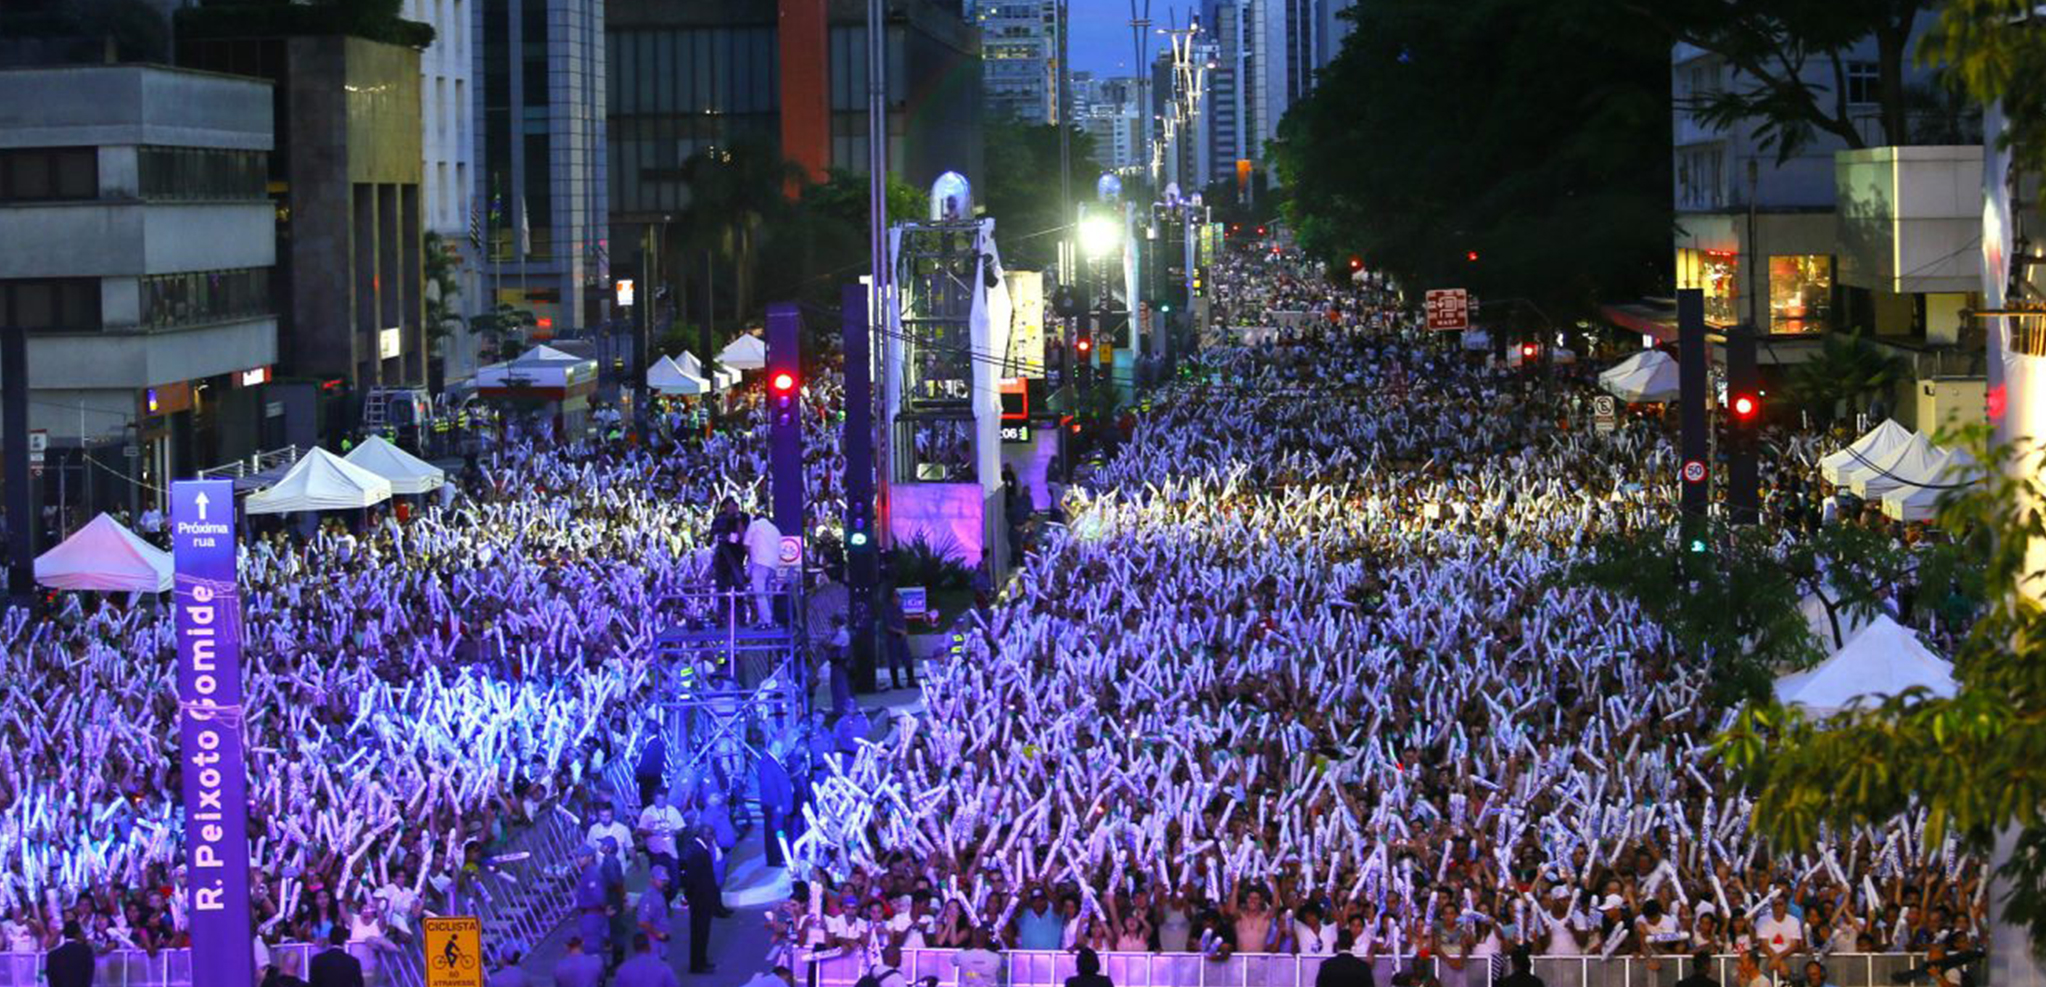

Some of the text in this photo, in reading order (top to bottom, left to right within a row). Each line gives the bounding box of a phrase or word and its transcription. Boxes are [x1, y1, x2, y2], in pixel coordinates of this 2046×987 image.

[1688, 465, 1702, 476] 50
[178, 522, 229, 534] Próxima
[193, 537, 216, 547] rua
[186, 586, 224, 910] R. Peixoto Gomide
[427, 922, 476, 931] CICLISTA
